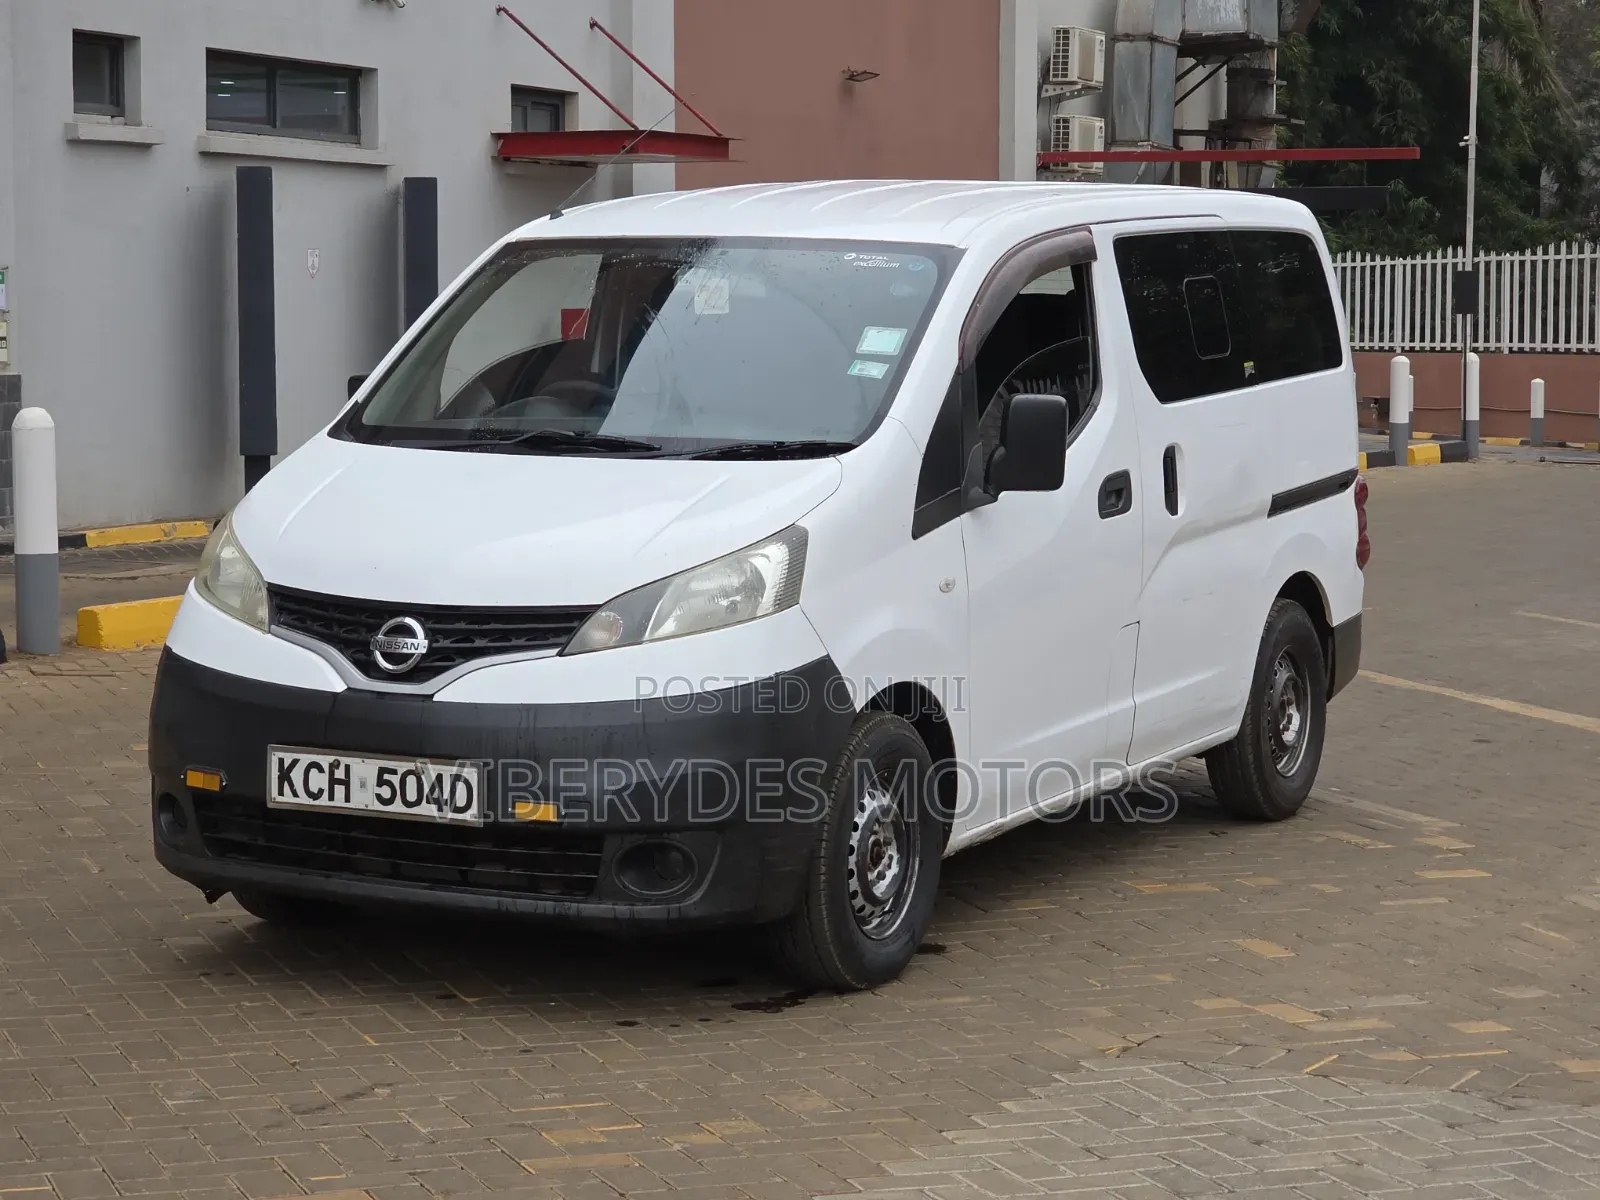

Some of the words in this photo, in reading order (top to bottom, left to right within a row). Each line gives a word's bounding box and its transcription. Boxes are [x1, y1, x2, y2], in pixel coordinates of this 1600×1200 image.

[853, 259, 900, 268] excellium
[376, 640, 420, 651] NISSAN
[277, 757, 351, 804] KCH
[374, 766, 474, 815] 504D
